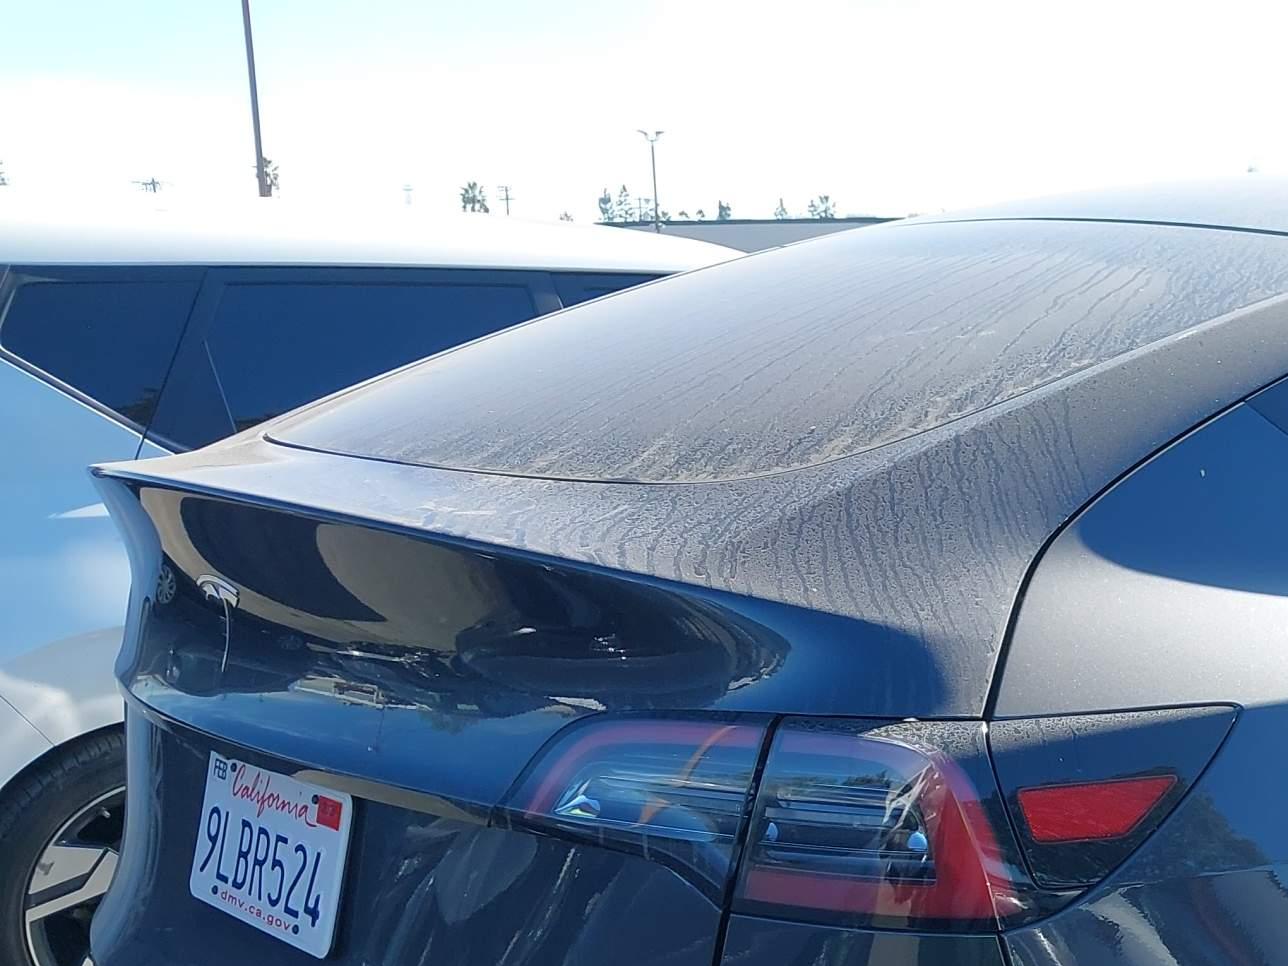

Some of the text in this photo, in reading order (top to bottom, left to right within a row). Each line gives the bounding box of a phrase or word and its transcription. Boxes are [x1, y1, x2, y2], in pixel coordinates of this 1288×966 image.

[213, 758, 228, 780] FEB
[231, 764, 317, 827] California
[199, 806, 322, 928] 9LBR524
[220, 889, 292, 931] dmv.ca.gov
